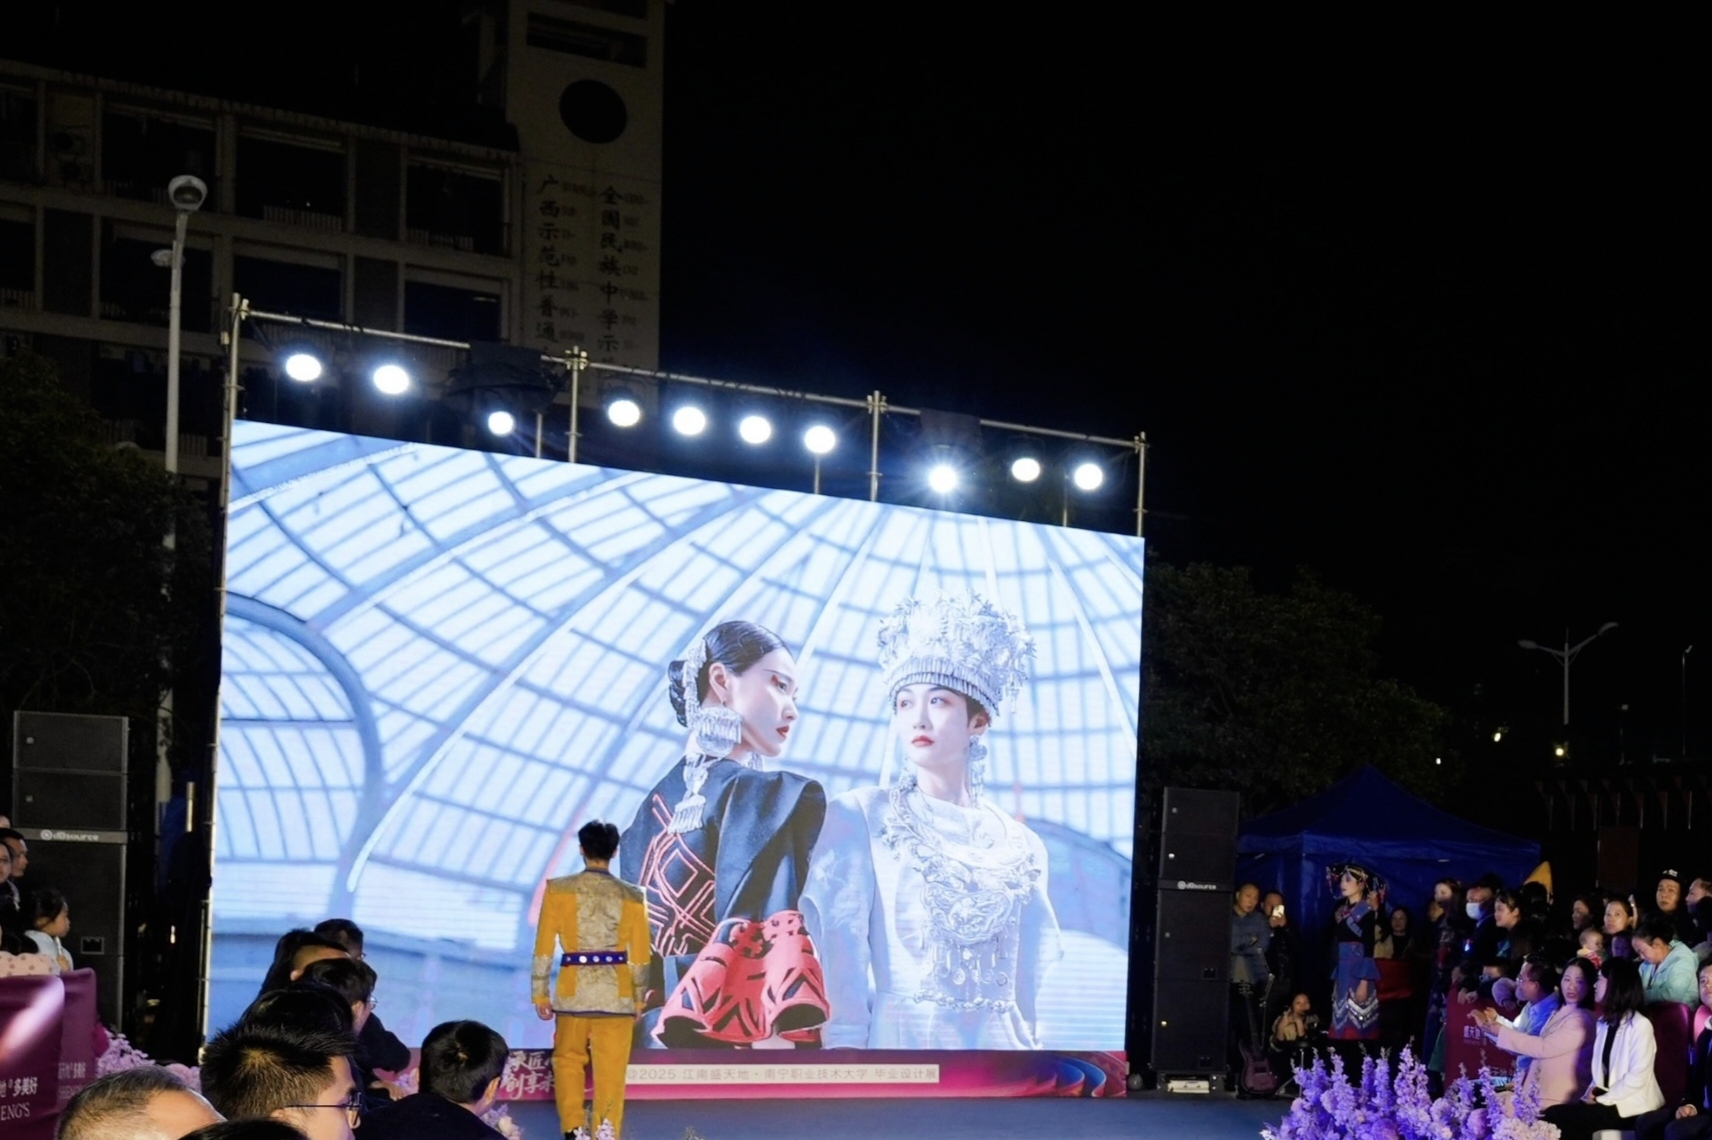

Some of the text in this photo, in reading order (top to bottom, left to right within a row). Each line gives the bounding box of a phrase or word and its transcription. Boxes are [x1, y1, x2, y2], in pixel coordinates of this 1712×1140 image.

[535, 173, 561, 356] 广西示范性普通
[597, 184, 625, 366] 全国民族中学示
[874, 1067, 938, 1080] 毕业设计展
